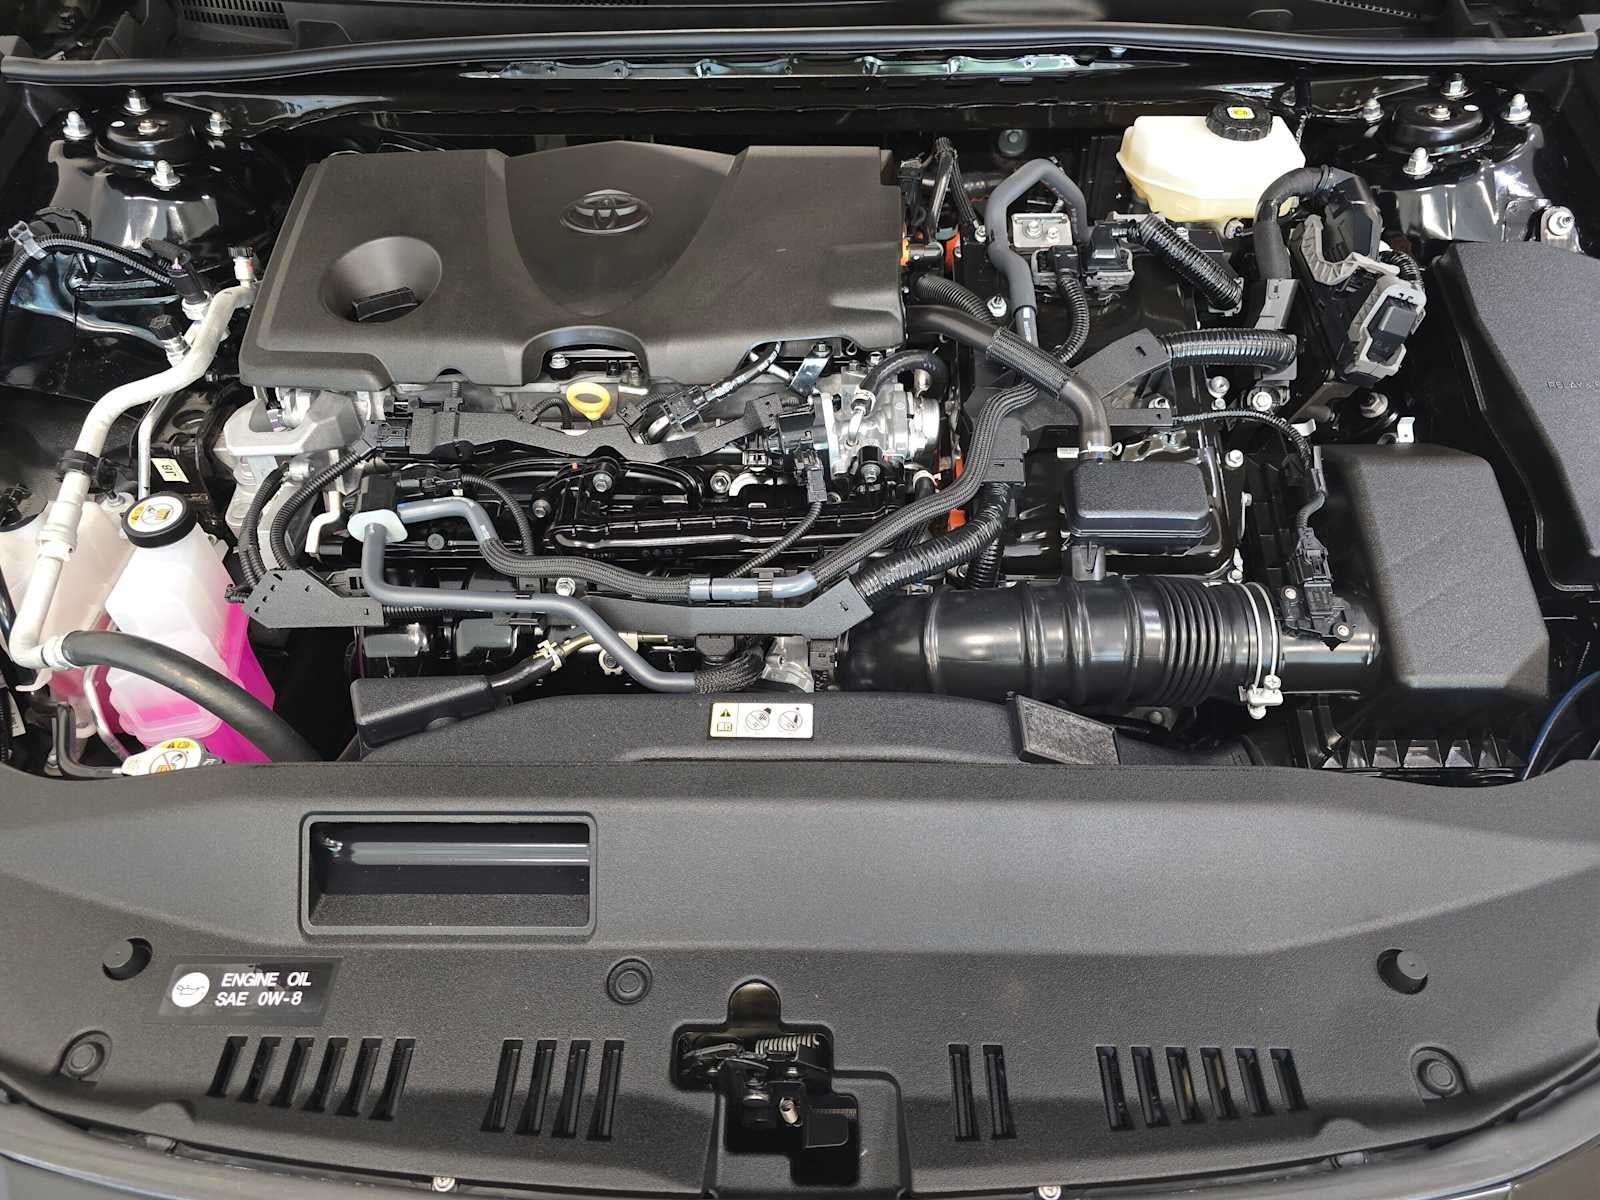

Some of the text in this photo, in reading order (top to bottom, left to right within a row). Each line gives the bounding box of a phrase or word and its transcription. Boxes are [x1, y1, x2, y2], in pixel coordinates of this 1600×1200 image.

[221, 972, 312, 987] ENGINE OIL
[214, 991, 303, 1007] SAE 0W-8
